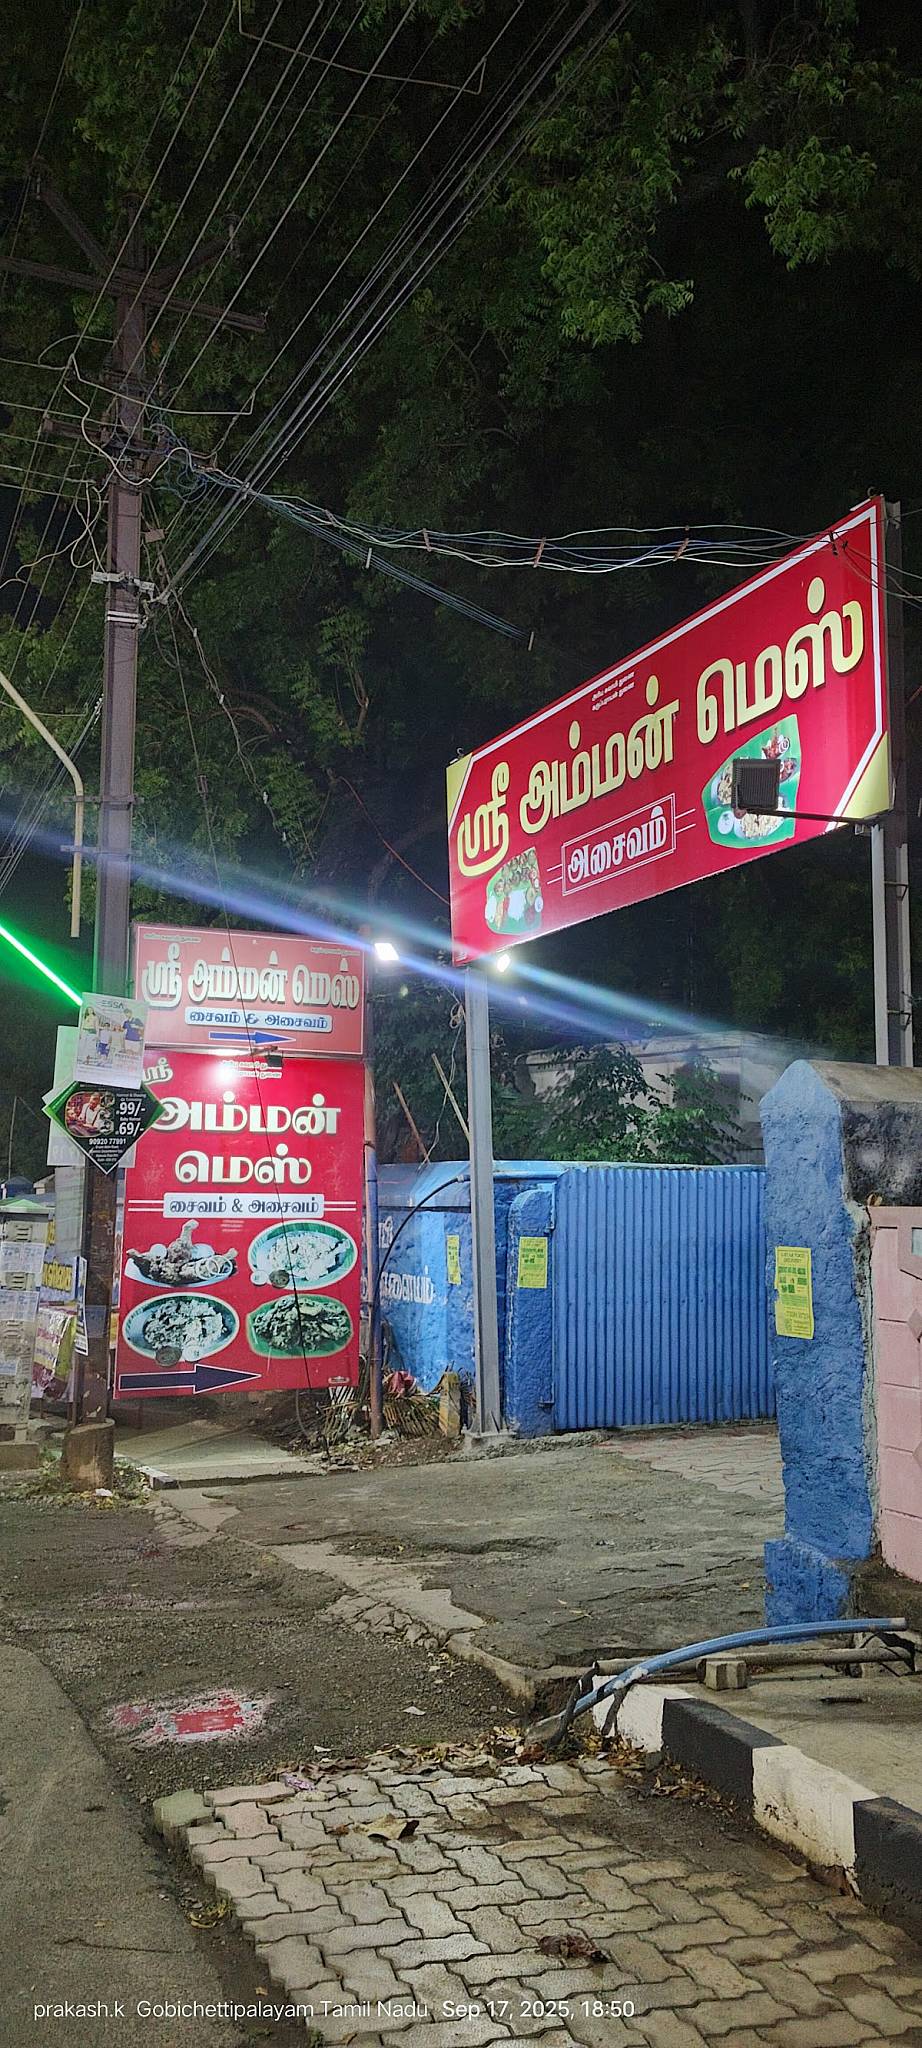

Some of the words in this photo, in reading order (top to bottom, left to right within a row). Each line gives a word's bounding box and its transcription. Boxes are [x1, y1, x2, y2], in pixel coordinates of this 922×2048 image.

[519, 675, 680, 835] அம்மன்
[696, 576, 865, 744] மெஸ்
[567, 806, 668, 884] அசைவம்
[187, 946, 288, 1003] அம்மன்
[292, 957, 360, 1009] மெஸ்
[189, 1011, 241, 1024] சைவம்
[245, 1013, 259, 1025] &
[264, 1014, 328, 1029] அசைவம்
[149, 1090, 342, 1135] அம்மன்
[174, 1143, 312, 1184] மெஸ்
[169, 1196, 227, 1213] சைவம்
[231, 1201, 243, 1213] &
[247, 1196, 319, 1214] அசைவம்
